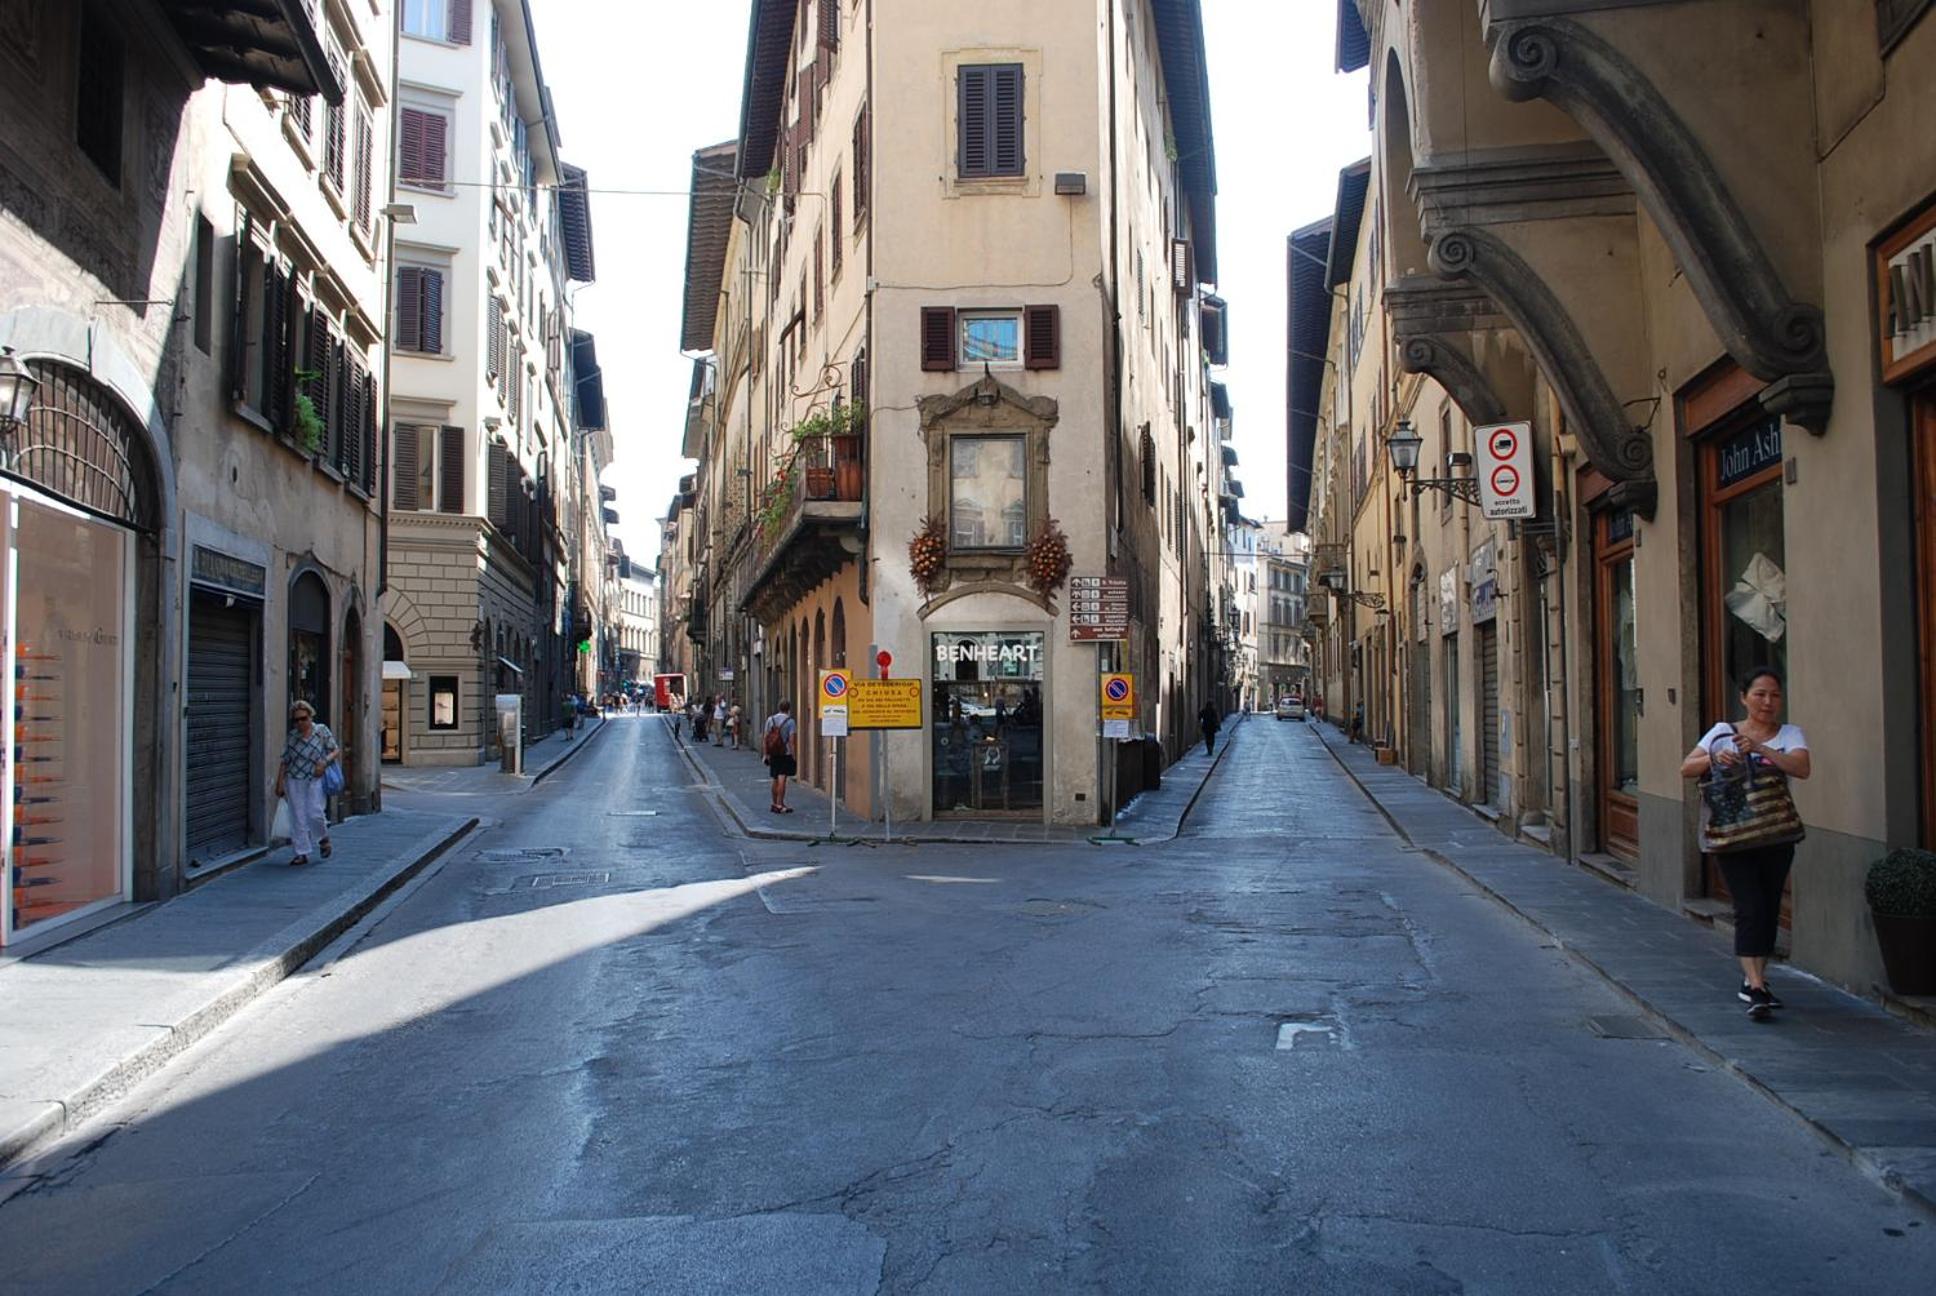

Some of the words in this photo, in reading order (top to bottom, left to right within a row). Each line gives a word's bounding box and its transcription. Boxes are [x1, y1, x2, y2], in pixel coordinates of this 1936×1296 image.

[1721, 443, 1750, 481] John
[1494, 498, 1521, 506] eccetto
[1490, 506, 1528, 516] autorizzati
[936, 644, 1038, 662] BENHEART
